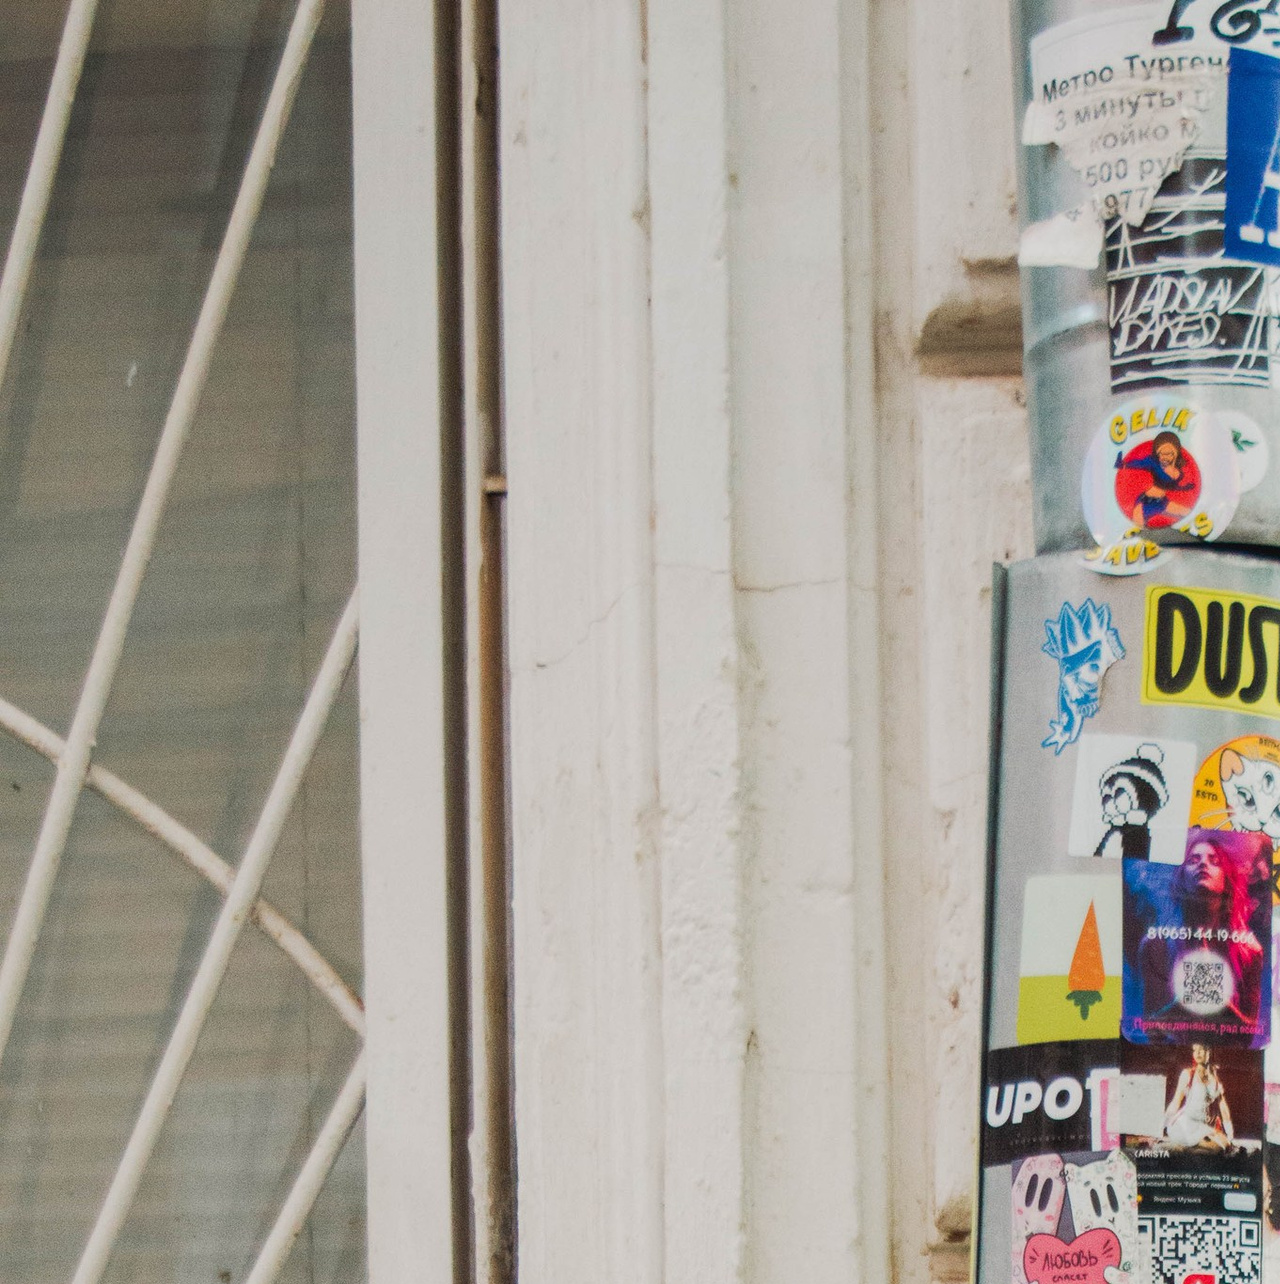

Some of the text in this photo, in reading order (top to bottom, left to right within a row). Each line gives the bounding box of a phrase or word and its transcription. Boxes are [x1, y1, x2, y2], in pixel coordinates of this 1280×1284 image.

[1043, 54, 1228, 103] Метро Турген
[986, 1076, 1092, 1128] UPO
